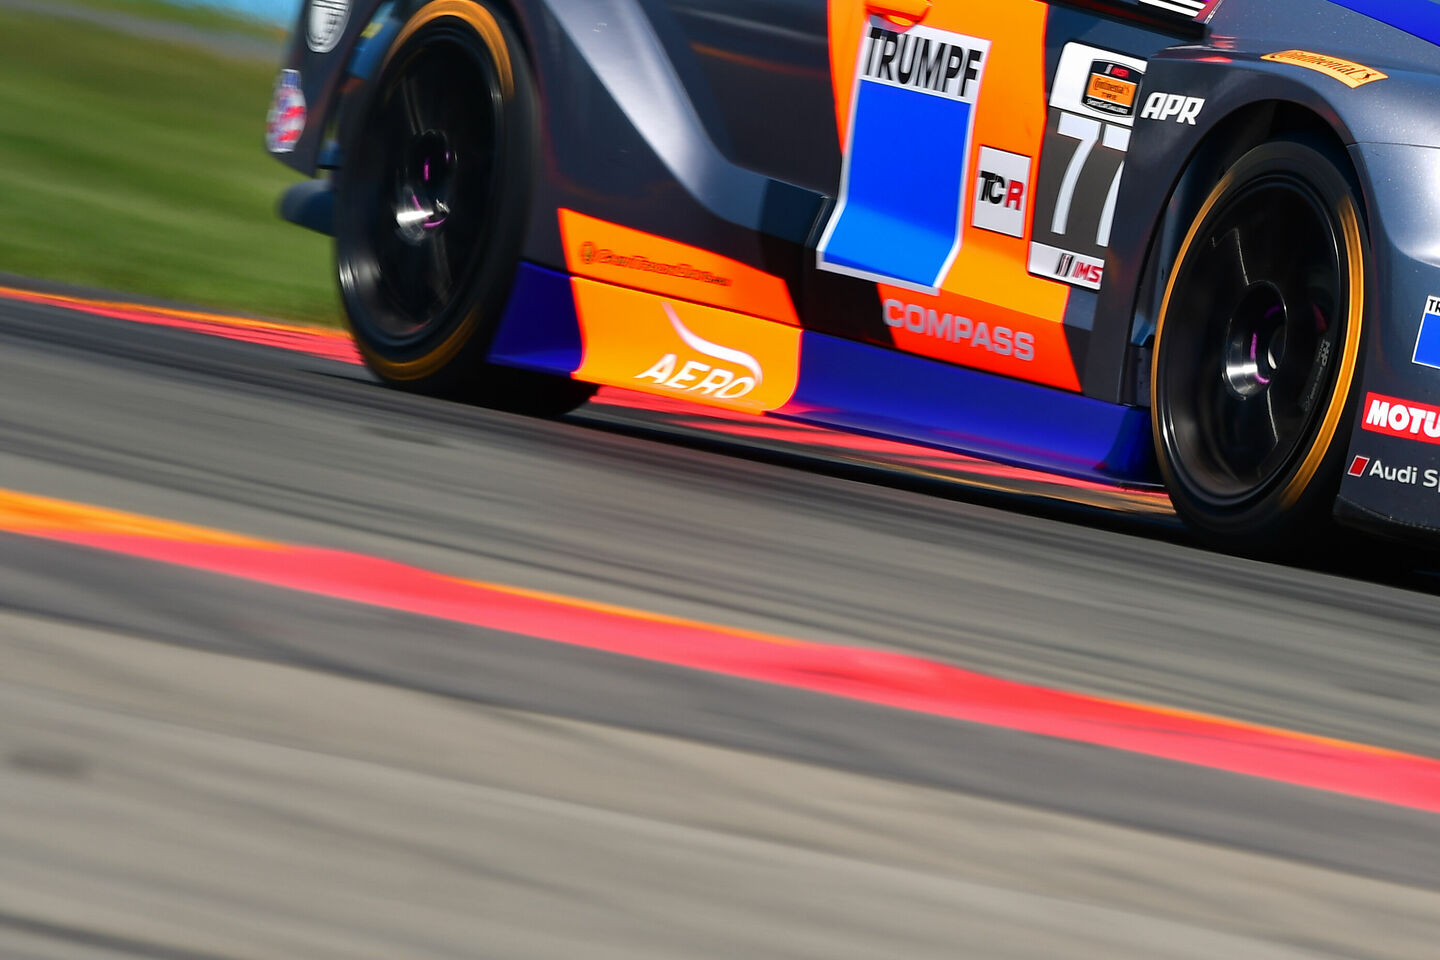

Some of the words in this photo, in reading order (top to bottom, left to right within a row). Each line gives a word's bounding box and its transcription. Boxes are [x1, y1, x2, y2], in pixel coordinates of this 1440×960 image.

[864, 27, 983, 97] TRUMPF
[1141, 92, 1205, 125] APR
[978, 170, 1024, 211] TCR
[1051, 112, 1132, 247] 77
[1073, 261, 1104, 283] IMS
[883, 299, 1035, 361] COMPASS
[633, 353, 755, 399] AERO
[1369, 460, 1417, 484] Audi
